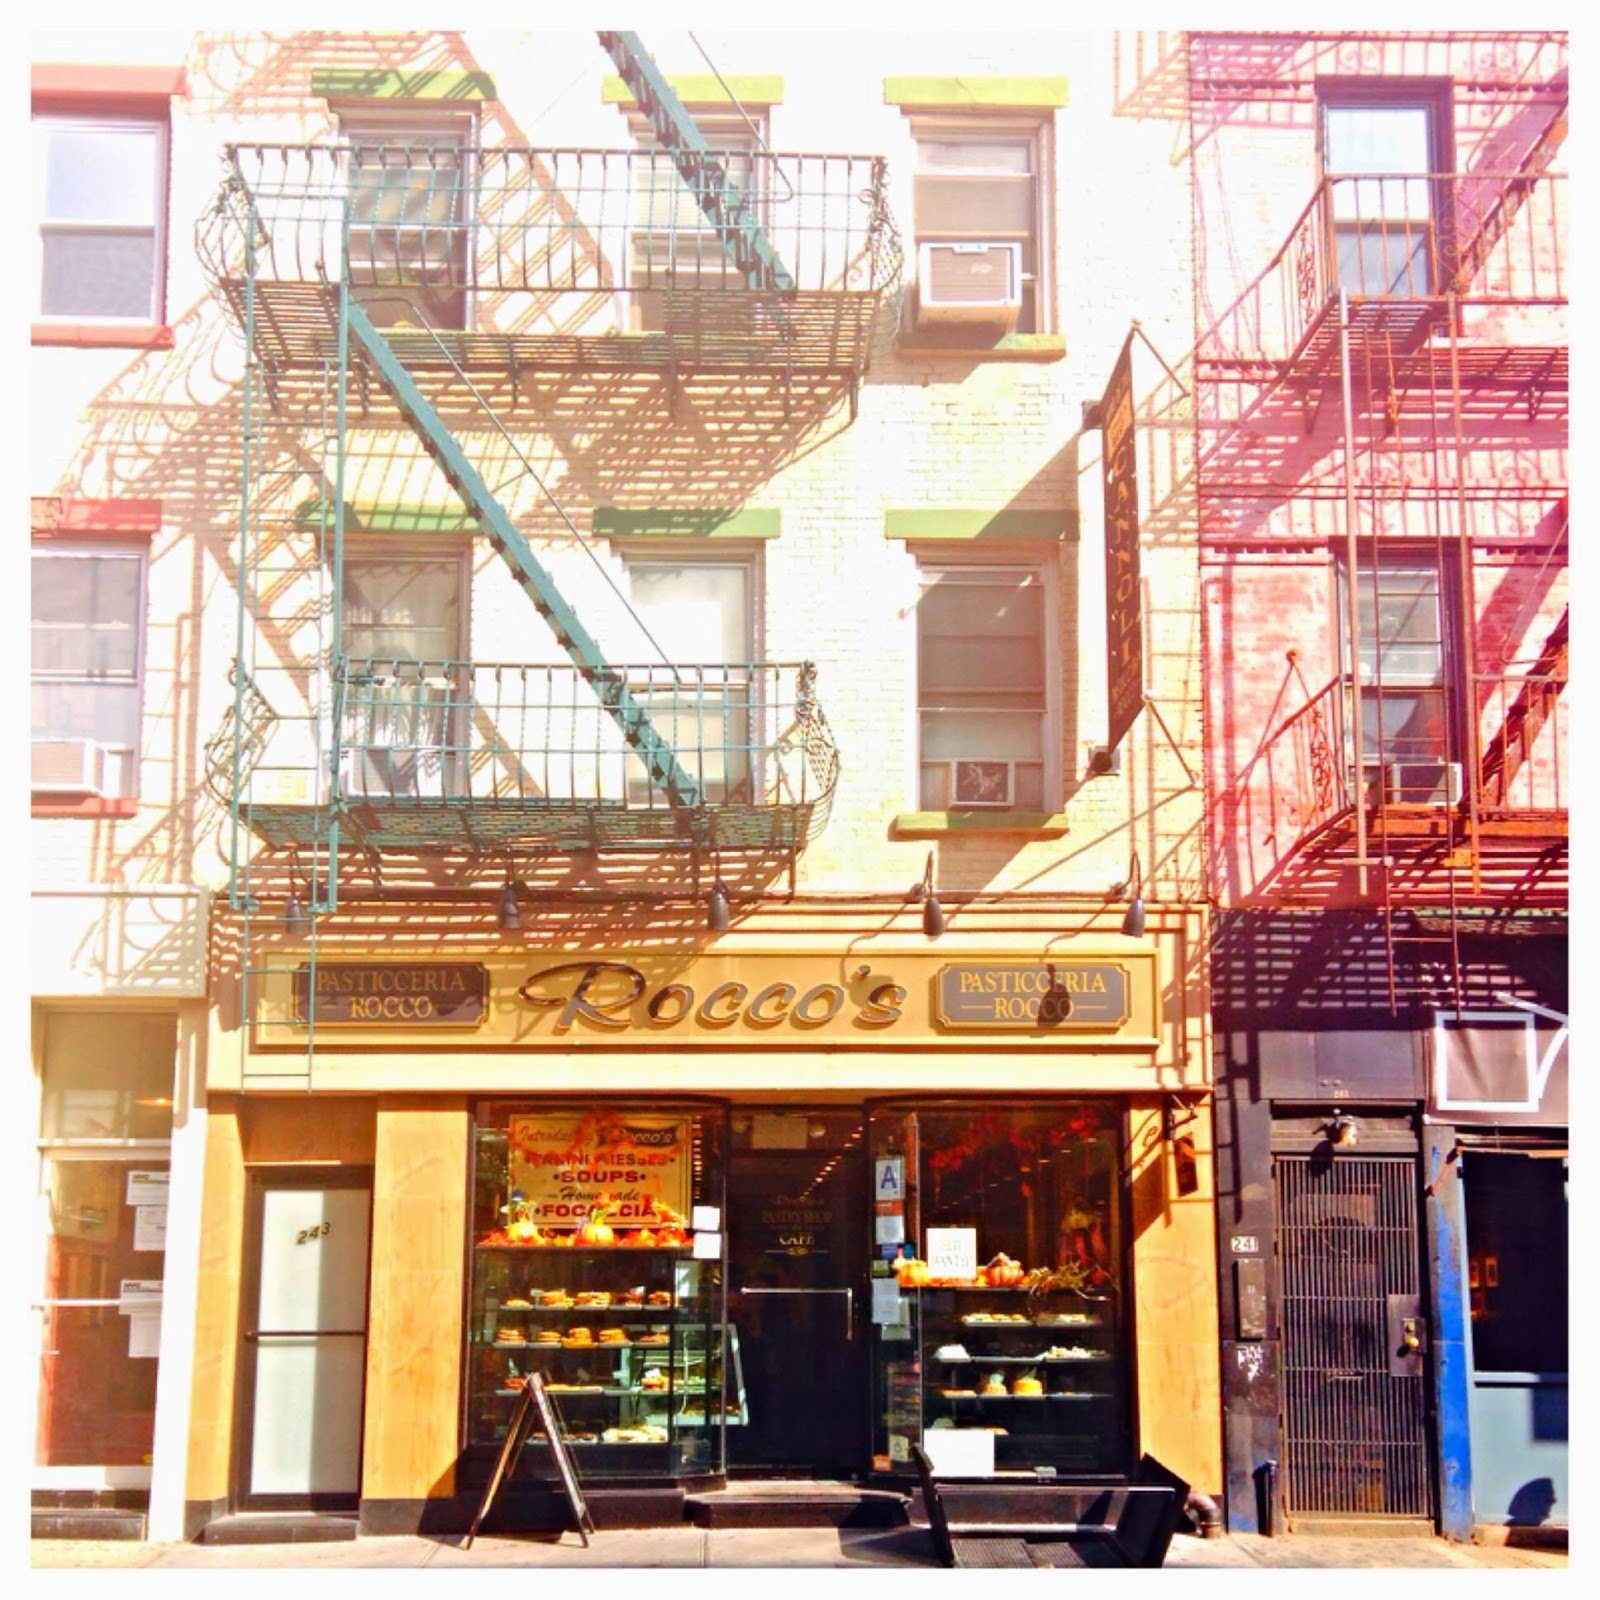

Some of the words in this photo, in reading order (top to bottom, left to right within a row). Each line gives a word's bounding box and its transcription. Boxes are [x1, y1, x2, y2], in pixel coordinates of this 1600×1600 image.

[1112, 446, 1134, 666] CANNOLI
[316, 970, 466, 992] PASTICCERIA
[959, 971, 1107, 993] PASTICCERIA
[518, 961, 907, 1030] Rocco's
[351, 996, 432, 1019] ROCCO
[994, 997, 1075, 1019] ROCCO
[529, 1153, 588, 1166] ANINI
[593, 1153, 668, 1166] ESSES
[559, 1169, 639, 1183] SOUPS
[881, 1165, 897, 1189] A
[559, 1185, 640, 1200] Homeade
[541, 1204, 656, 1217] FOCACIA
[296, 1222, 331, 1245] 243
